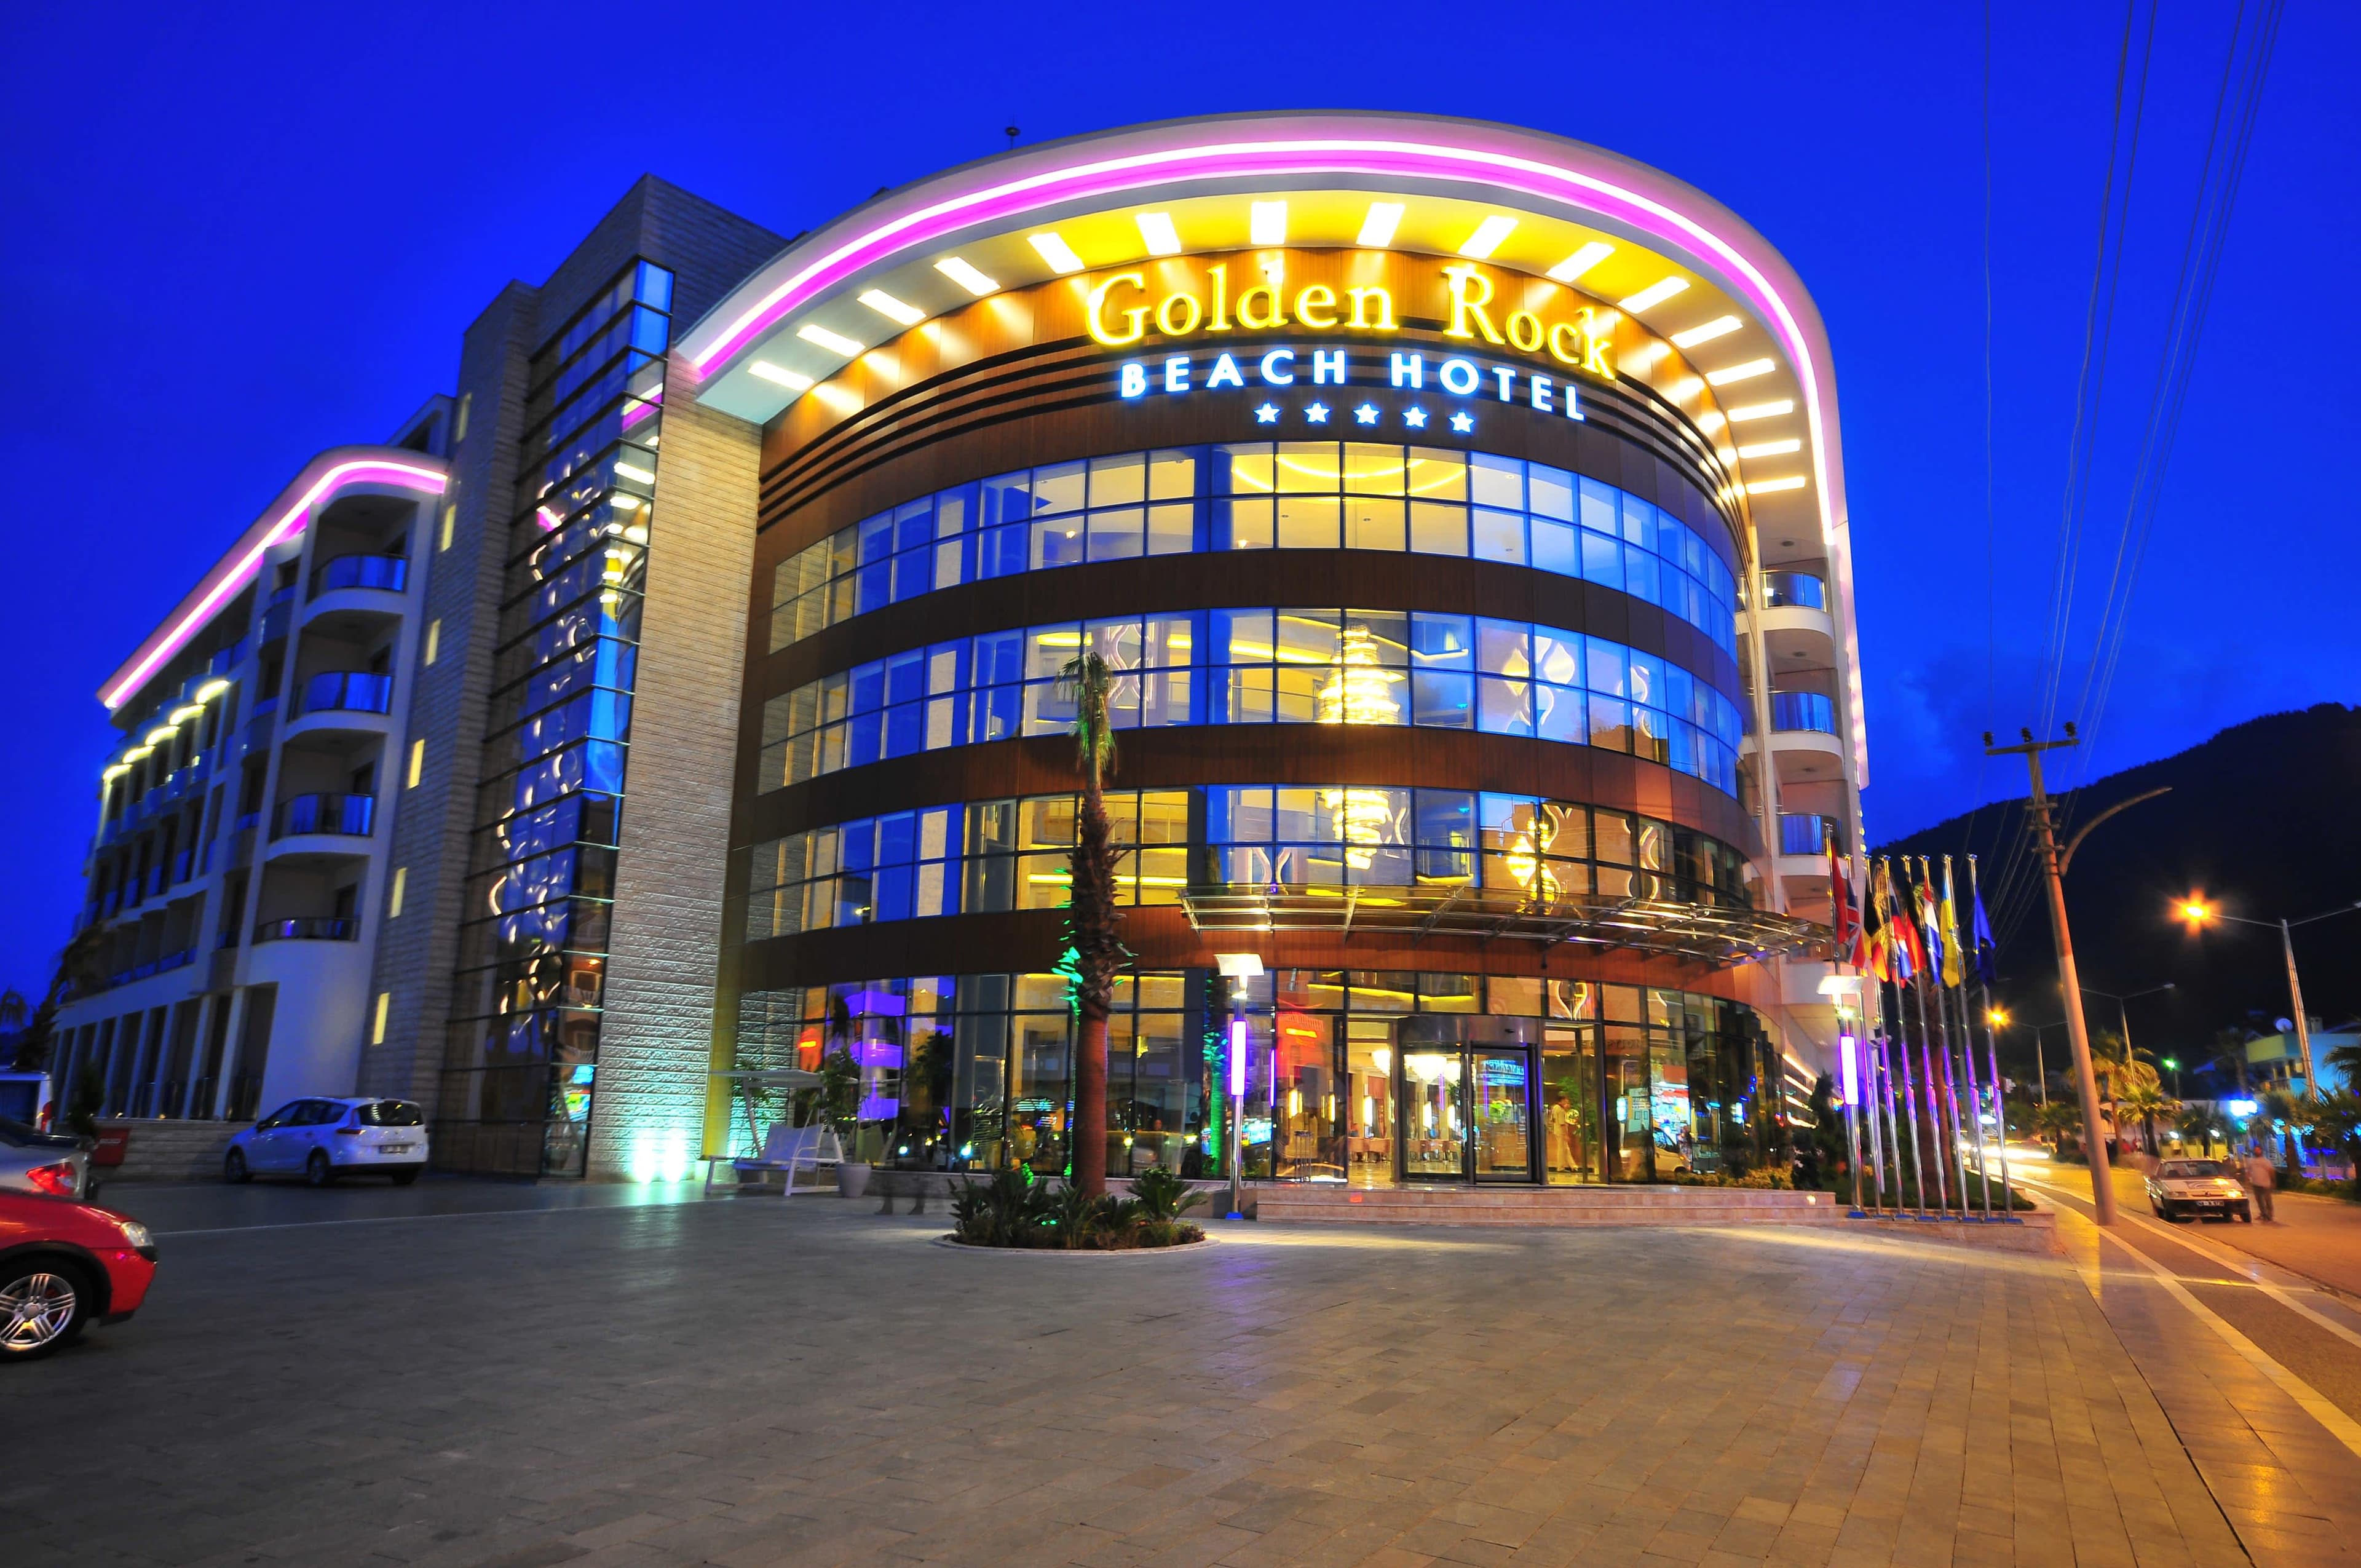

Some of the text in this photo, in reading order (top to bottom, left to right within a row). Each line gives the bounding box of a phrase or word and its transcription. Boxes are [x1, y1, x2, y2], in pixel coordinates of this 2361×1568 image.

[1085, 260, 1616, 381] Golden Rock
[1120, 348, 1585, 422] BEACH HOTEL
